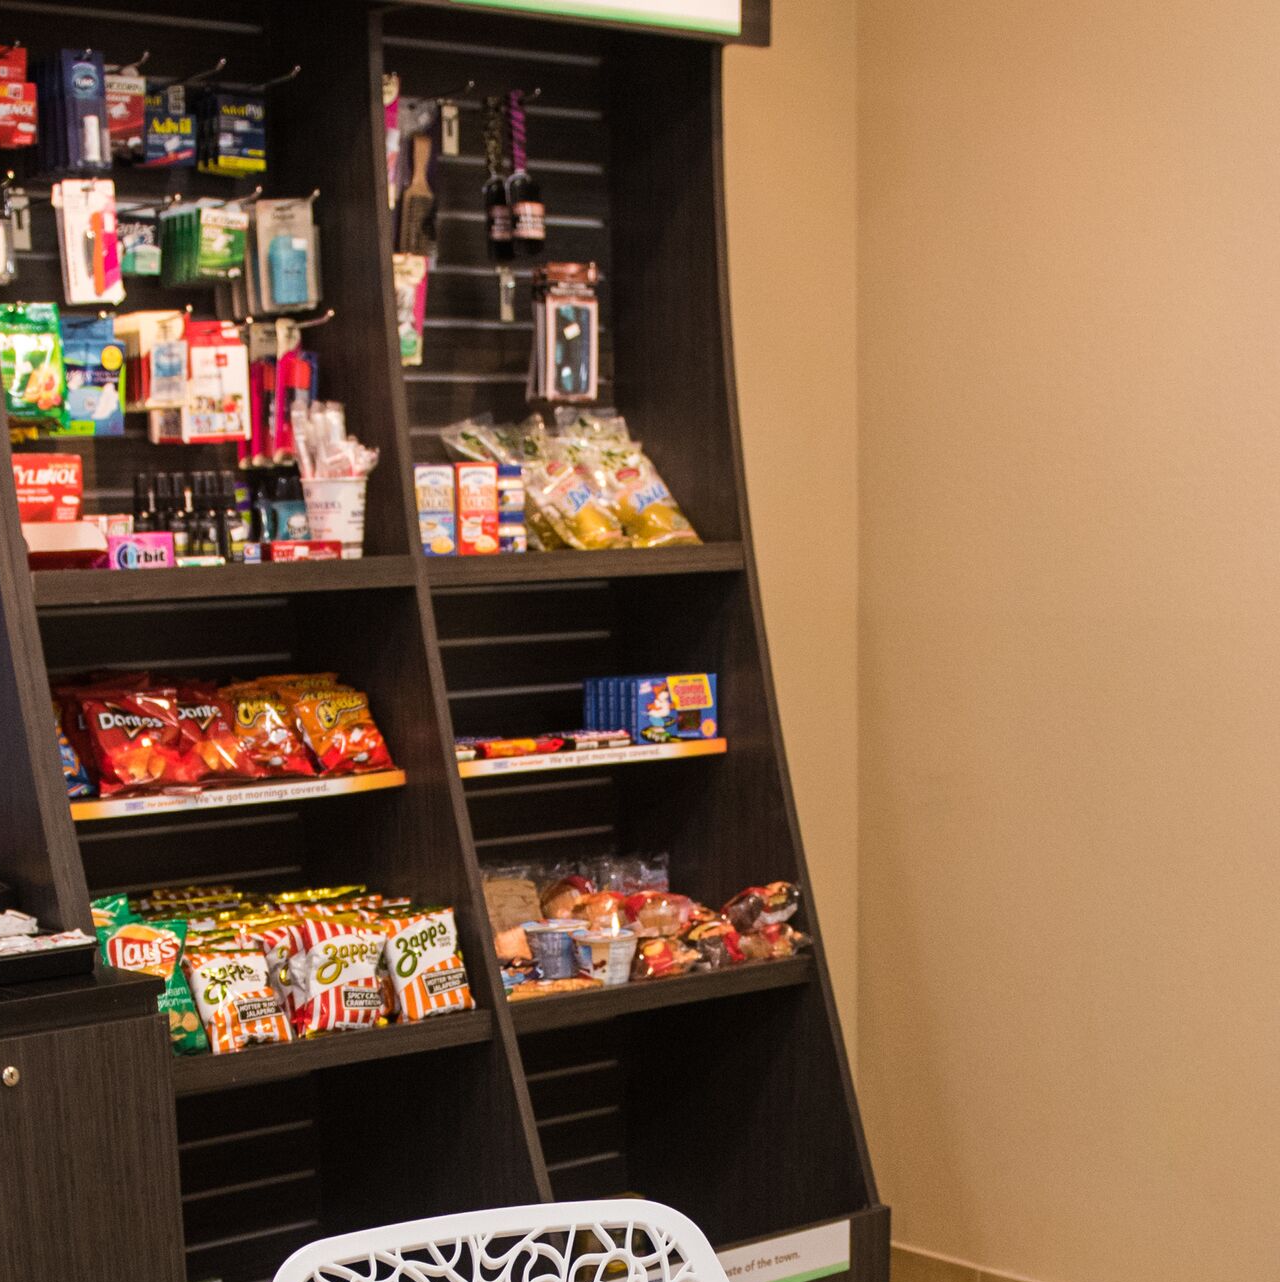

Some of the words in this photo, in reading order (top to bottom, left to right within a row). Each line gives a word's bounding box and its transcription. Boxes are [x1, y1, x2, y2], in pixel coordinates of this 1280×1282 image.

[117, 543, 166, 569] Orbit
[98, 711, 164, 730] Doritos
[194, 794, 224, 805] We've
[227, 793, 243, 803] got
[246, 788, 289, 799] mornings
[290, 784, 330, 796] covered.
[347, 992, 366, 1000] SPICY
[238, 1001, 263, 1012] HOTTER
[745, 1261, 756, 1273] of
[756, 1257, 772, 1270] the
[774, 1251, 801, 1266] town.
